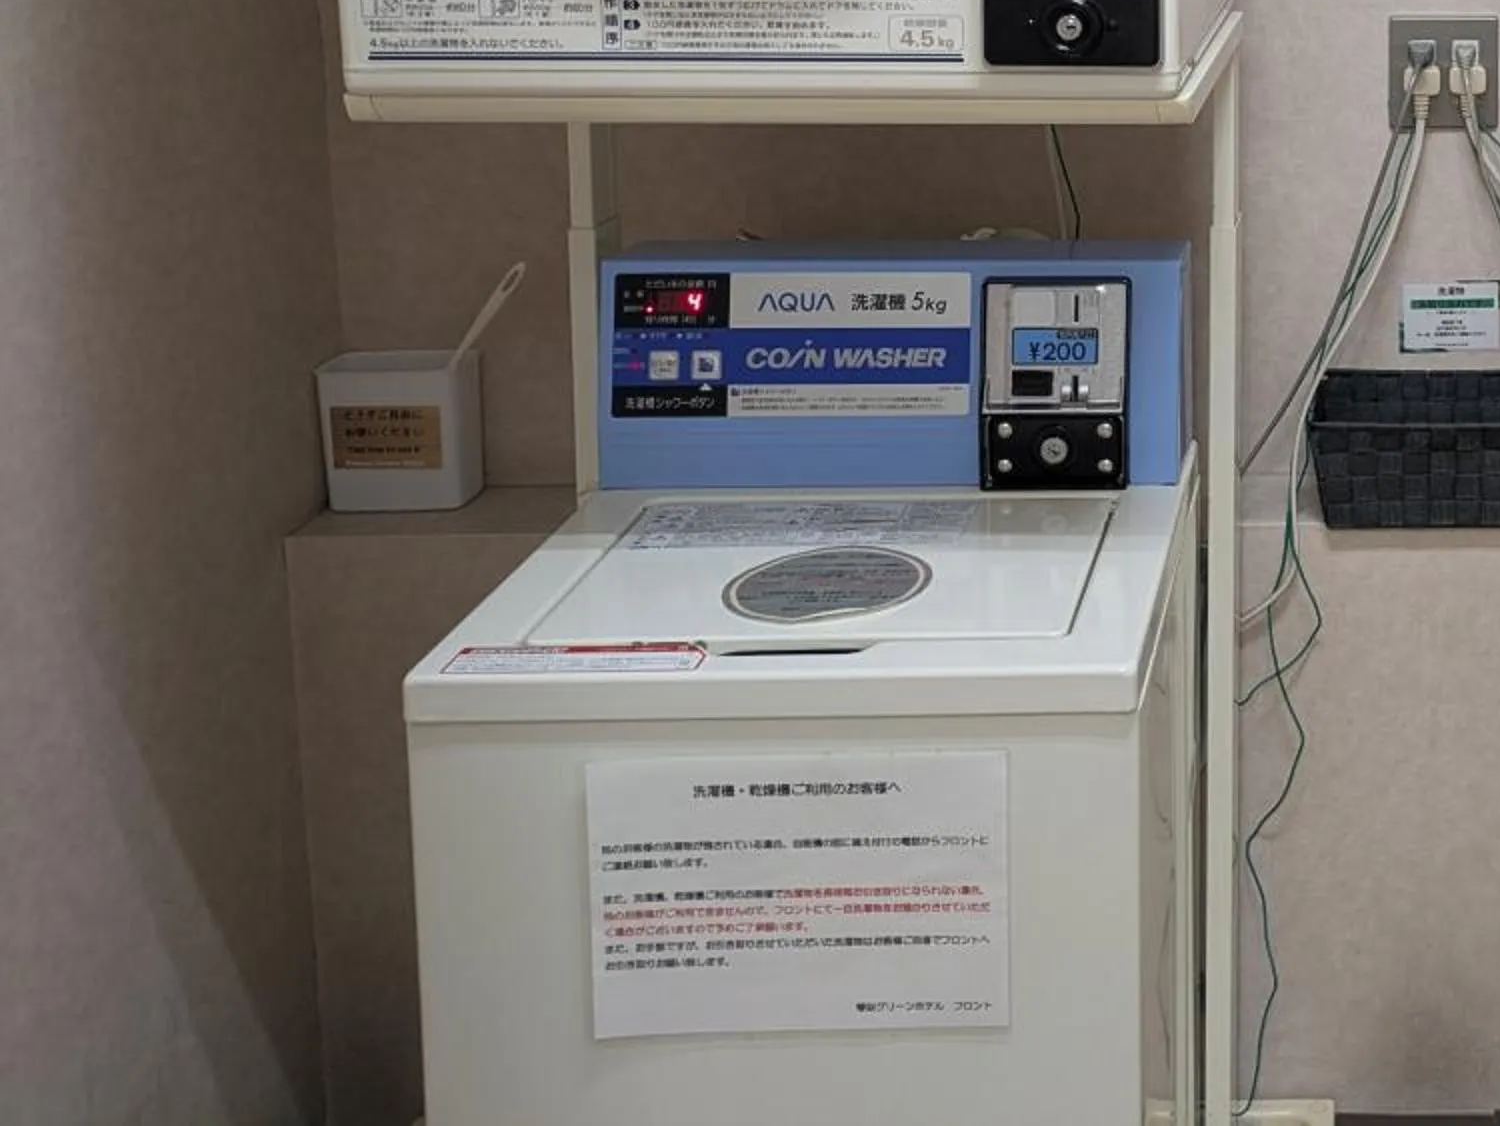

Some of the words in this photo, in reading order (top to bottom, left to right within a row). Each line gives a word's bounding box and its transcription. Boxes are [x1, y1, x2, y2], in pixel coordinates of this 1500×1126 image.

[687, 293, 703, 311] 4
[757, 292, 836, 313] AQUA
[851, 293, 906, 311] 洗濯機
[911, 291, 947, 315] 5kg
[746, 339, 826, 370] COIN
[833, 347, 947, 369] WASHER
[1028, 341, 1087, 362] ¥200
[693, 781, 902, 798] 洗濯機・乾燥機ご利用のお客様へ
